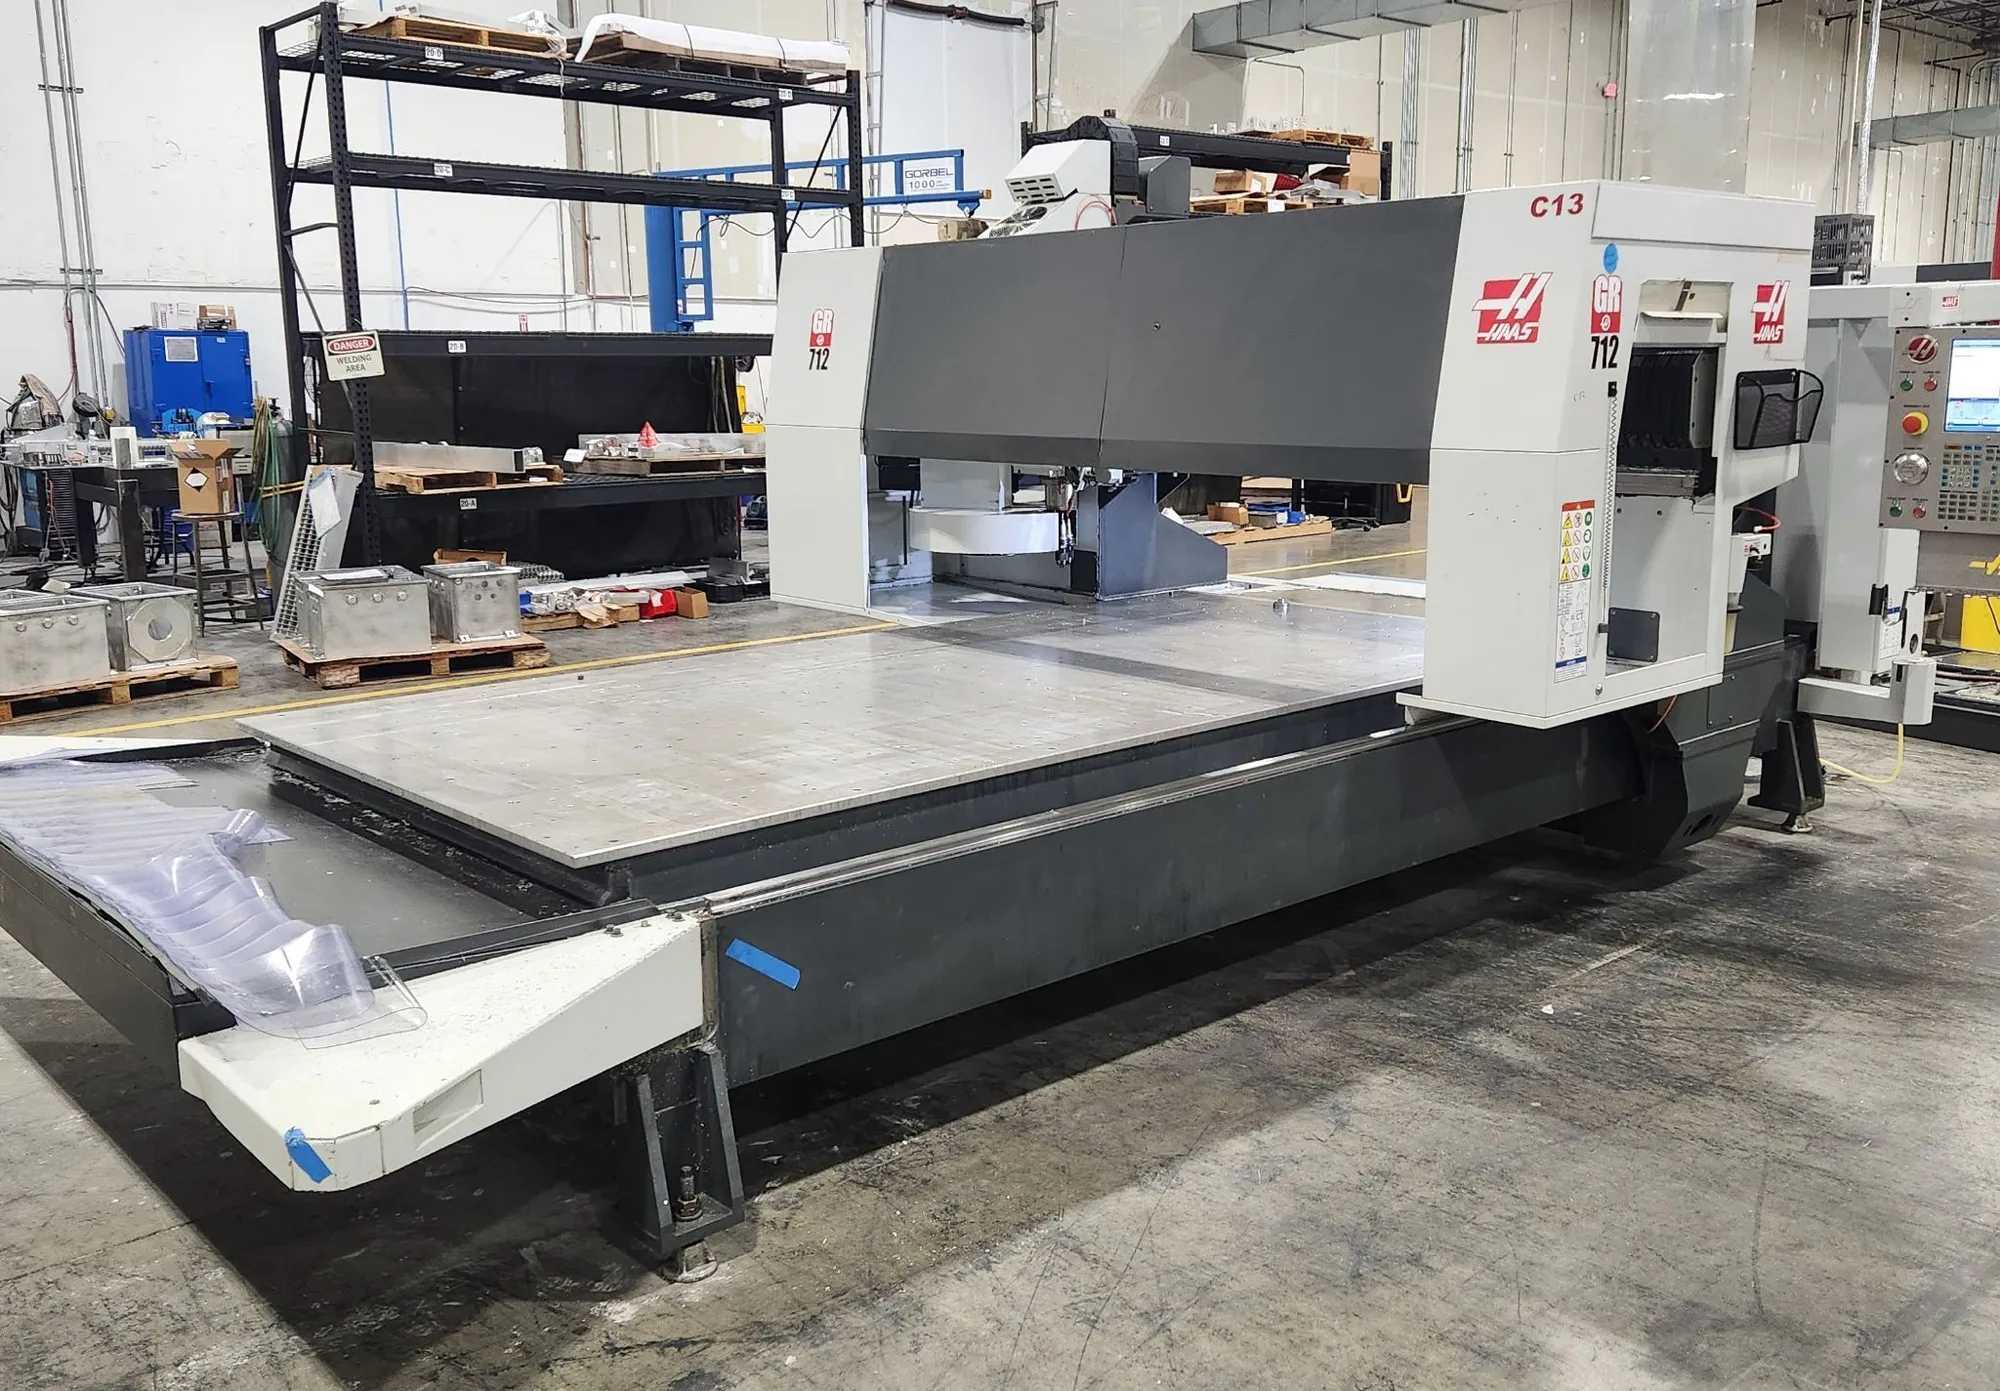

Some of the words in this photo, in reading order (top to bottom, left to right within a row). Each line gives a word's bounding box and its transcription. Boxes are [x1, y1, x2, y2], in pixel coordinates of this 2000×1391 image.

[904, 168, 954, 179] GORBEL
[909, 179, 936, 190] 1000
[1530, 193, 1584, 218] C13
[1593, 274, 1623, 314] GR
[811, 309, 834, 334] GR
[1477, 322, 1539, 342] HAAS
[1753, 324, 1785, 343] HAAS
[332, 338, 375, 352] DANGER
[1591, 335, 1620, 369] 712
[336, 353, 372, 367] WELDING
[345, 363, 367, 374] AREA
[809, 348, 830, 370] 712
